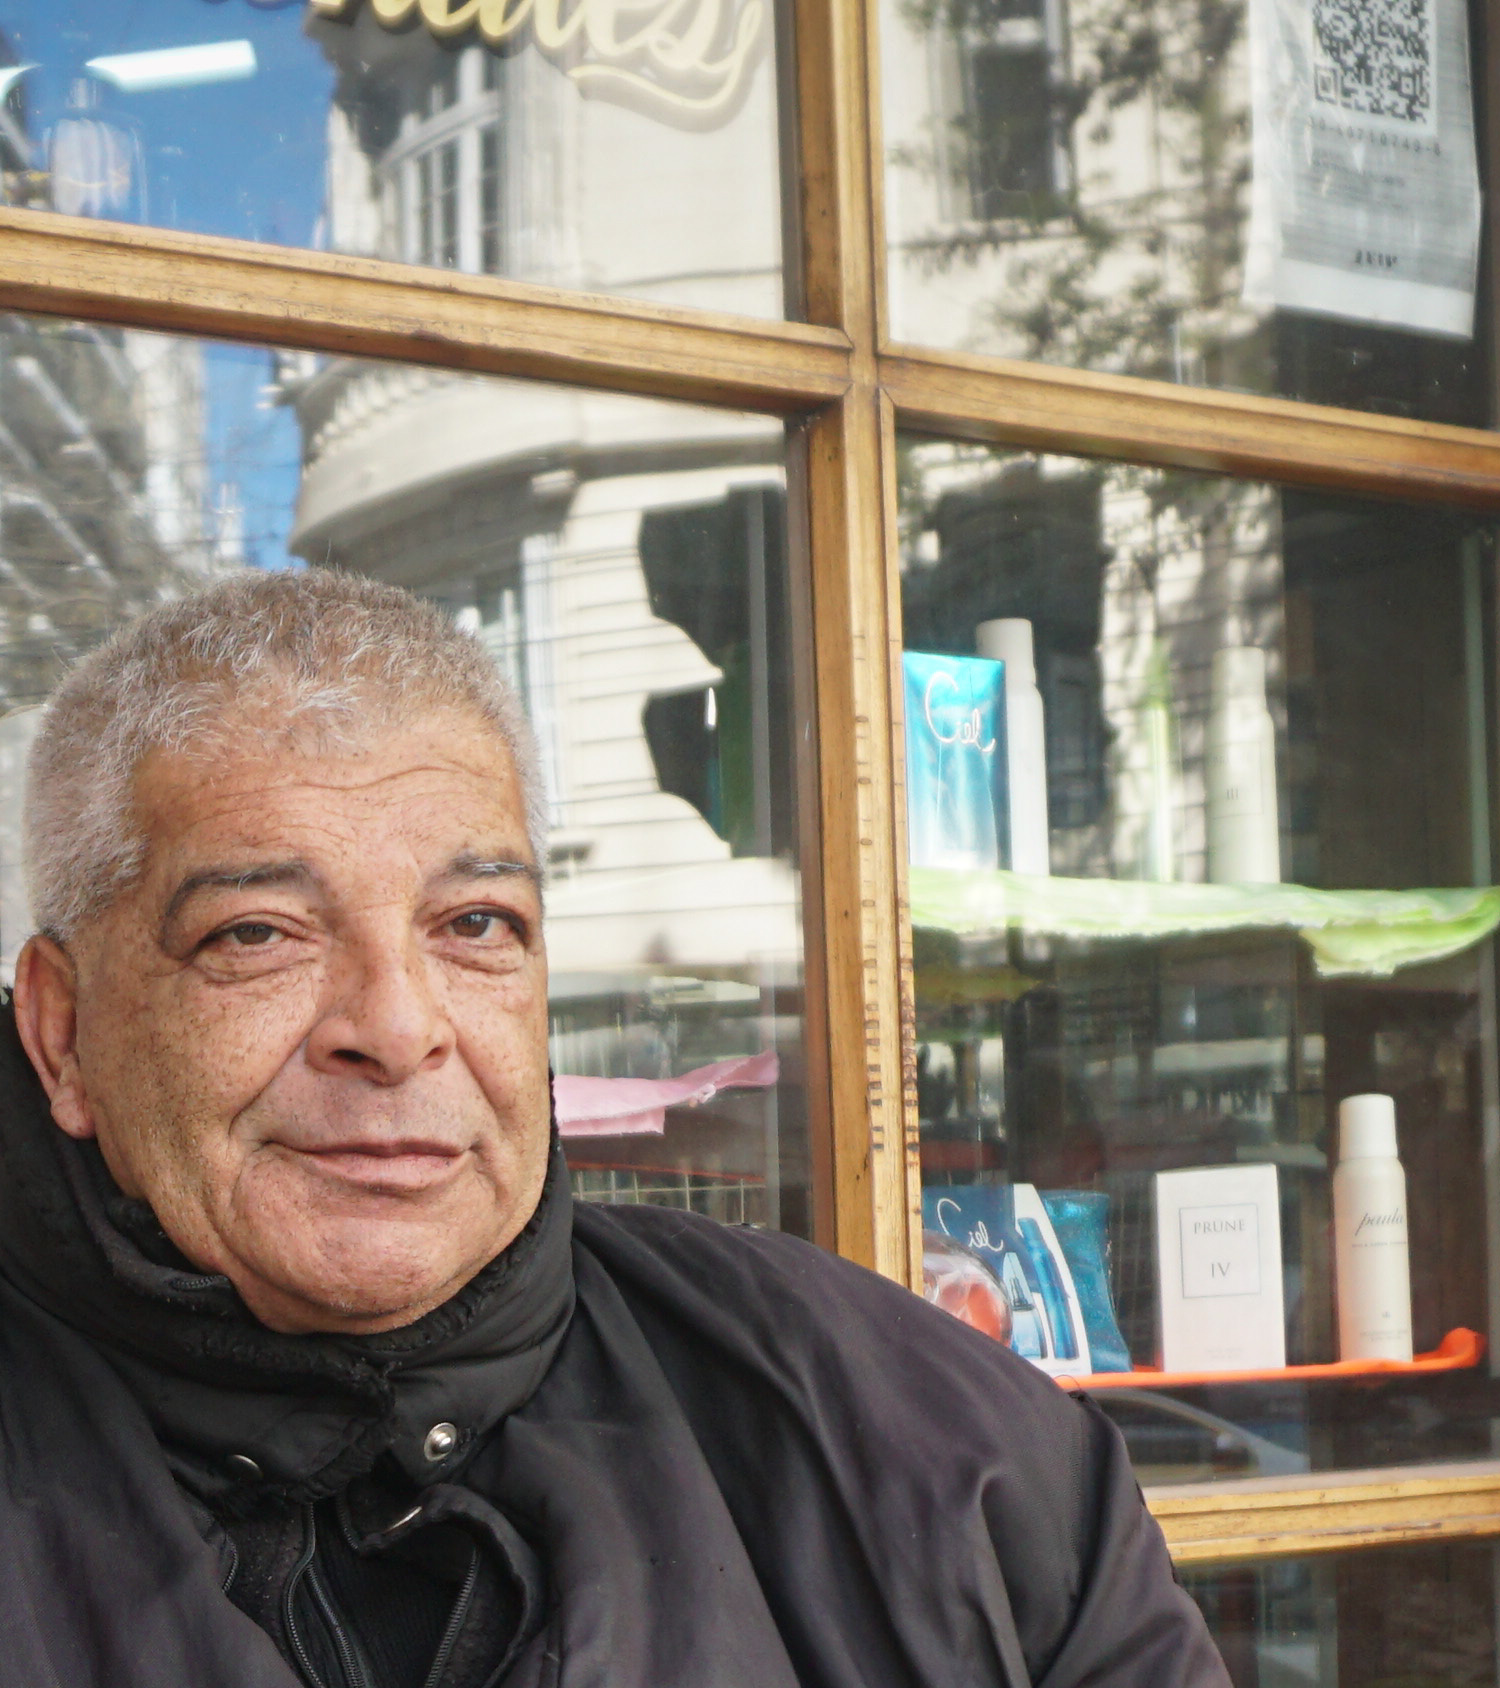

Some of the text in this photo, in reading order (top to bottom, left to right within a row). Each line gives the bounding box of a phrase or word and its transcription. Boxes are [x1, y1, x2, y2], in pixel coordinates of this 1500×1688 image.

[925, 670, 996, 752] Ciel
[1193, 1218, 1247, 1235] PRÜNE
[1210, 1261, 1232, 1279] IV
